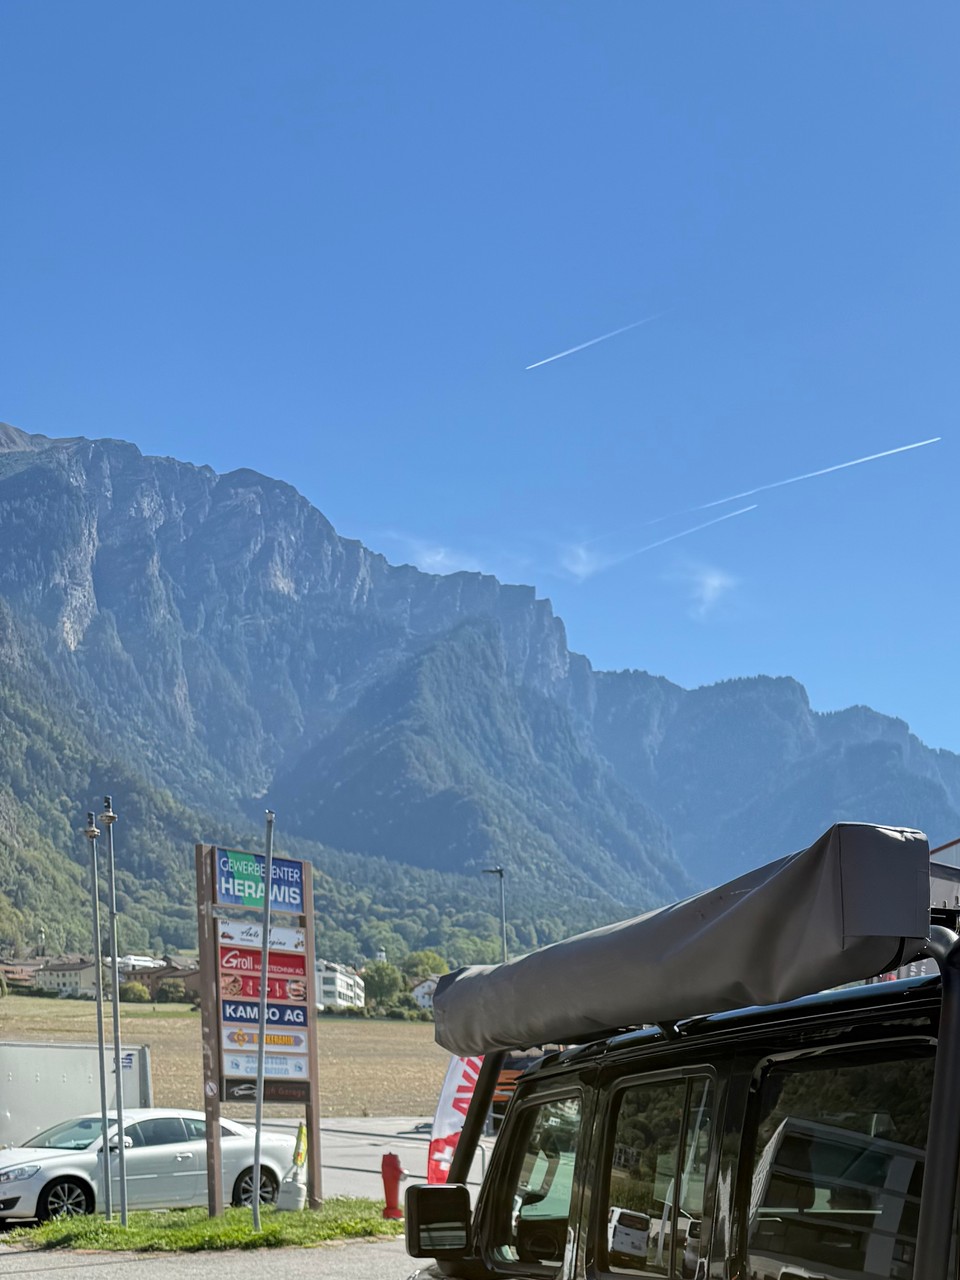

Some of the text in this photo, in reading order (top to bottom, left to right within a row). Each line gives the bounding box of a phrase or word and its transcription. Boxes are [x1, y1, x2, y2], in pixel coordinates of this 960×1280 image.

[220, 857, 300, 882] GEWERBEENTER
[222, 950, 253, 970] Groll
[284, 1009, 304, 1022] AG
[451, 1055, 485, 1117] AVI
